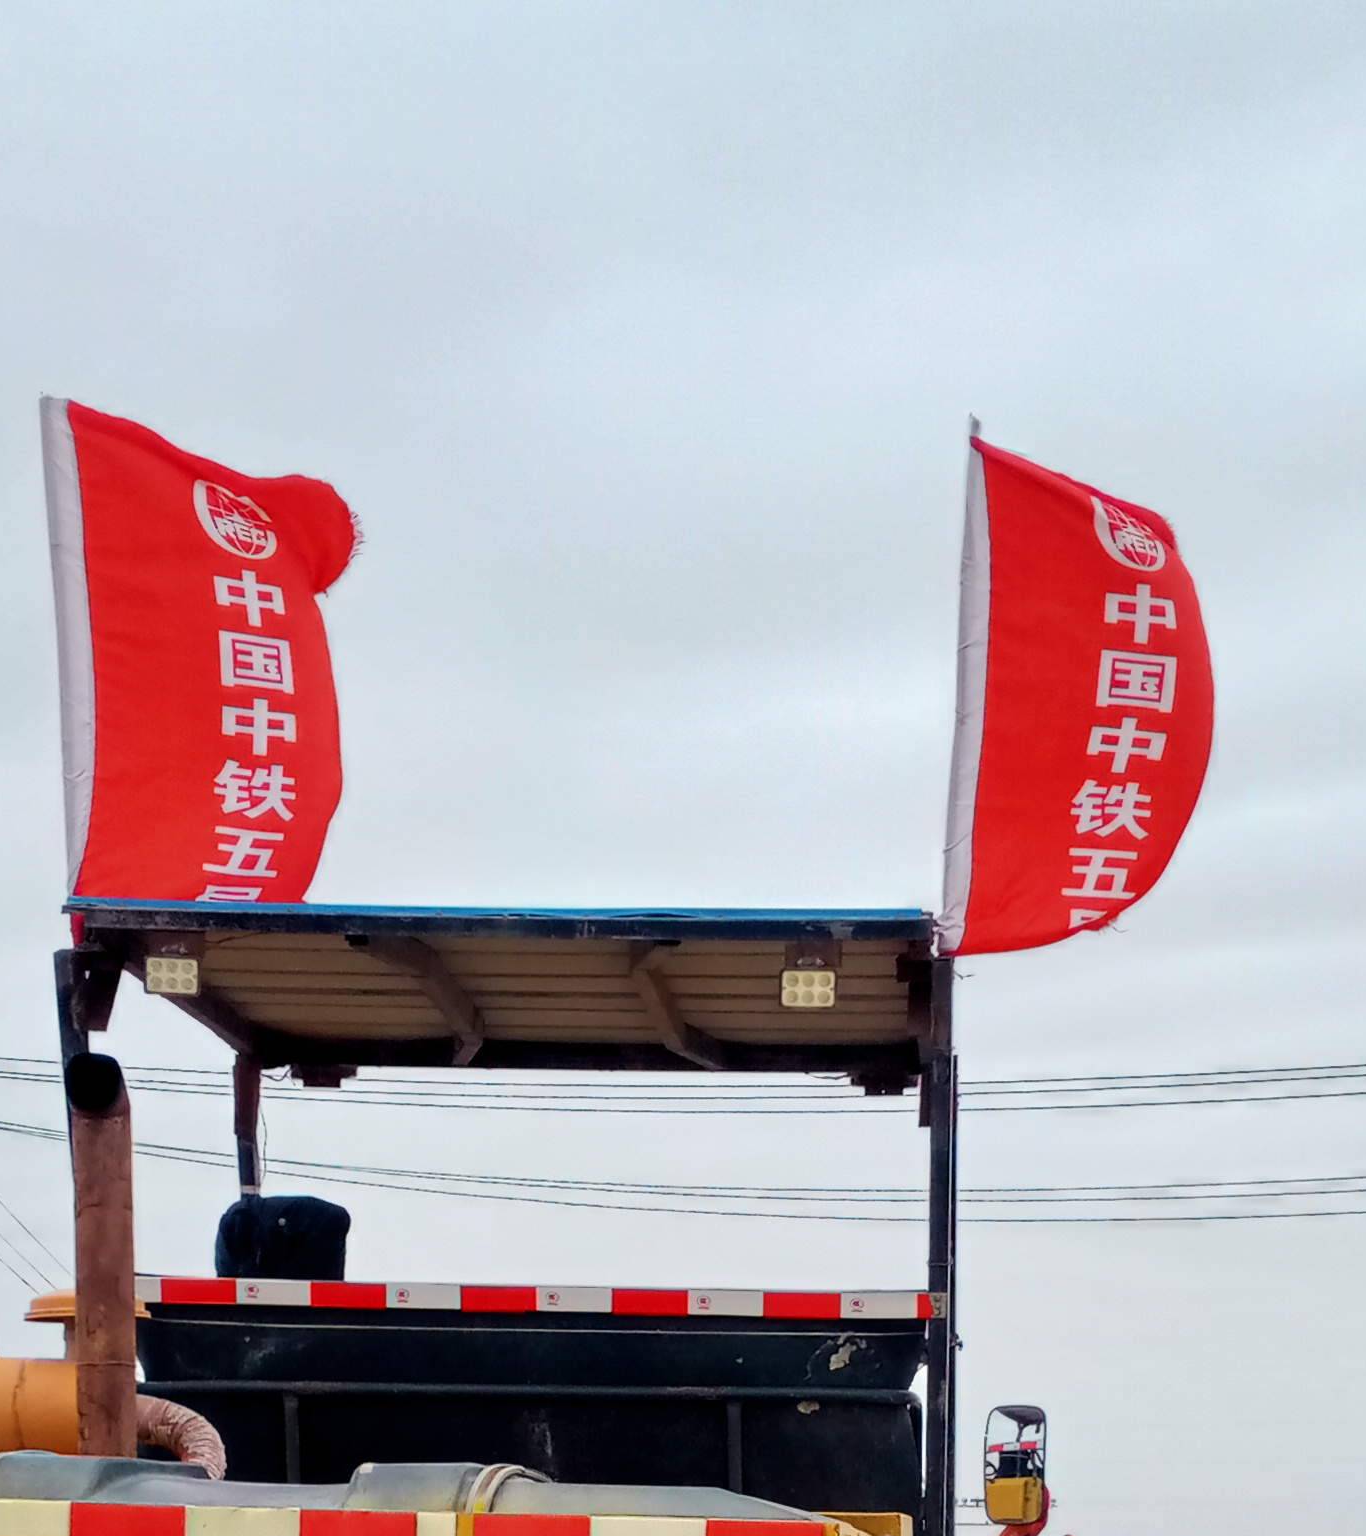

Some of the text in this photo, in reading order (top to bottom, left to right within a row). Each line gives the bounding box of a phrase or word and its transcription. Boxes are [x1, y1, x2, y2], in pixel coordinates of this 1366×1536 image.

[1061, 583, 1177, 929] 中国中铁五
